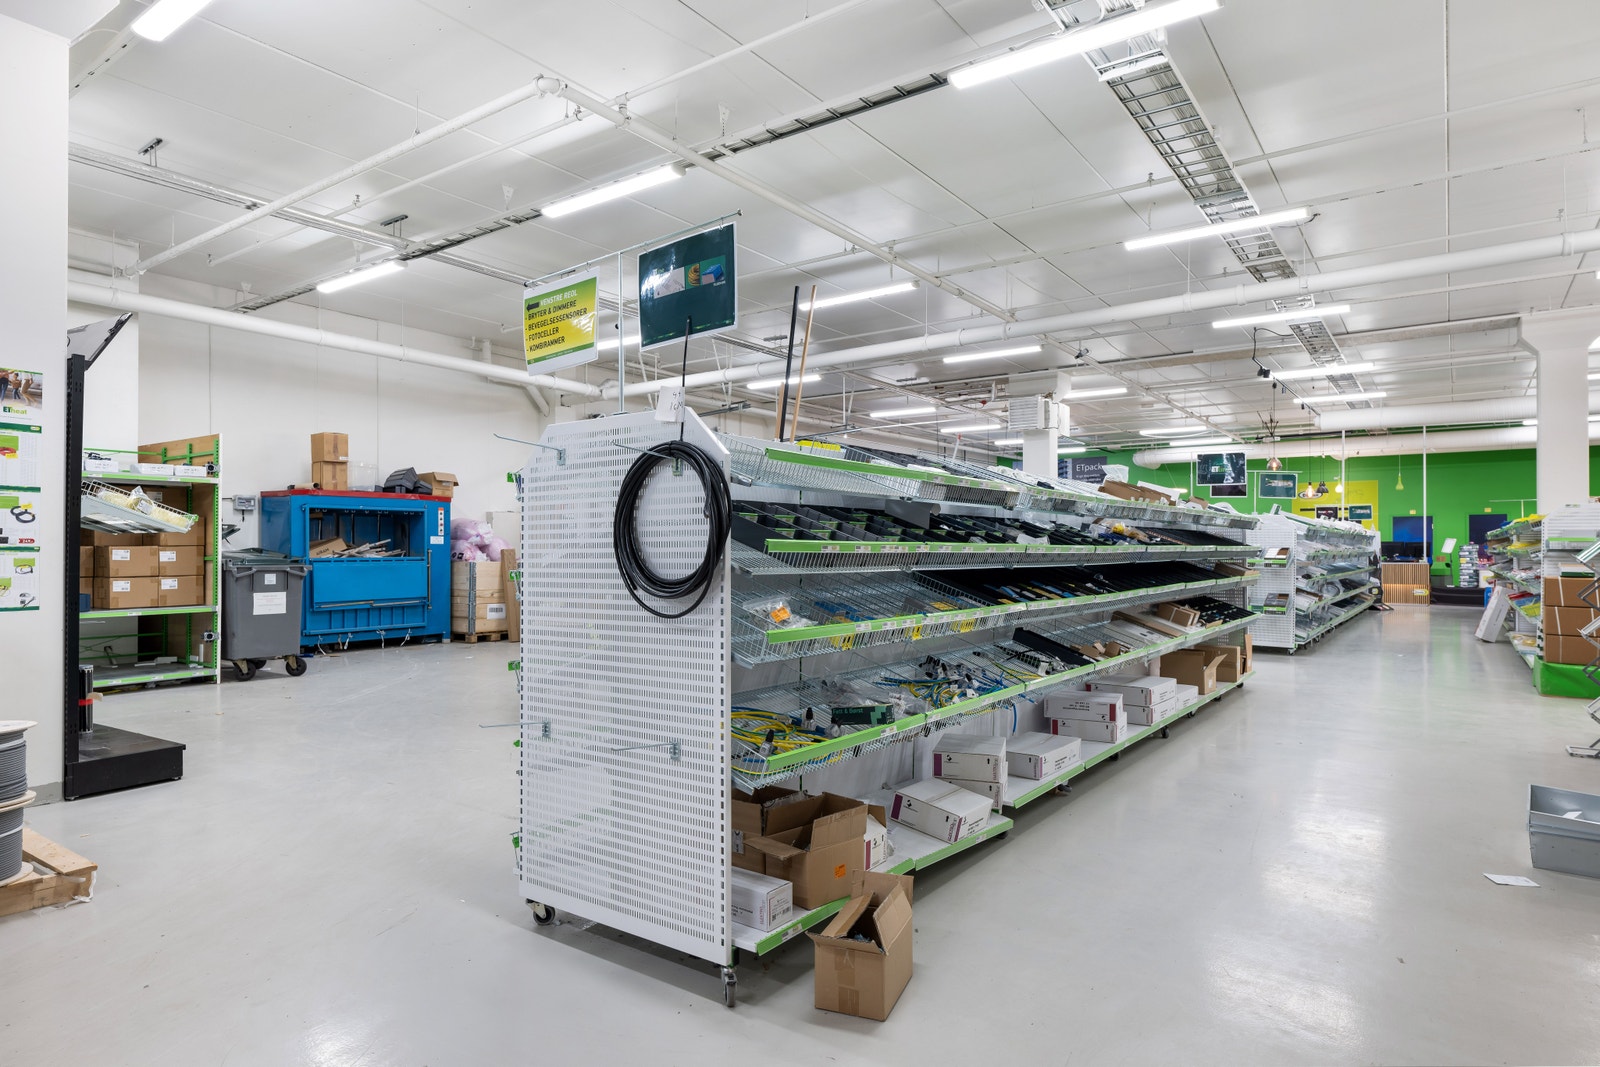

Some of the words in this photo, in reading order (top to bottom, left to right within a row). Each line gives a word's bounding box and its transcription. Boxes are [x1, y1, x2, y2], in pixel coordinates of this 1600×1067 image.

[563, 289, 578, 299] REOL
[528, 308, 547, 321] BRYTER
[547, 307, 552, 315] &
[552, 299, 577, 312] DIMMERE
[528, 307, 588, 331] BEVEGELSESSENSORER
[528, 326, 560, 341] FOTOCELLER
[529, 336, 566, 352] KOMBIRAMMER
[3, 406, 28, 415] ETheat
